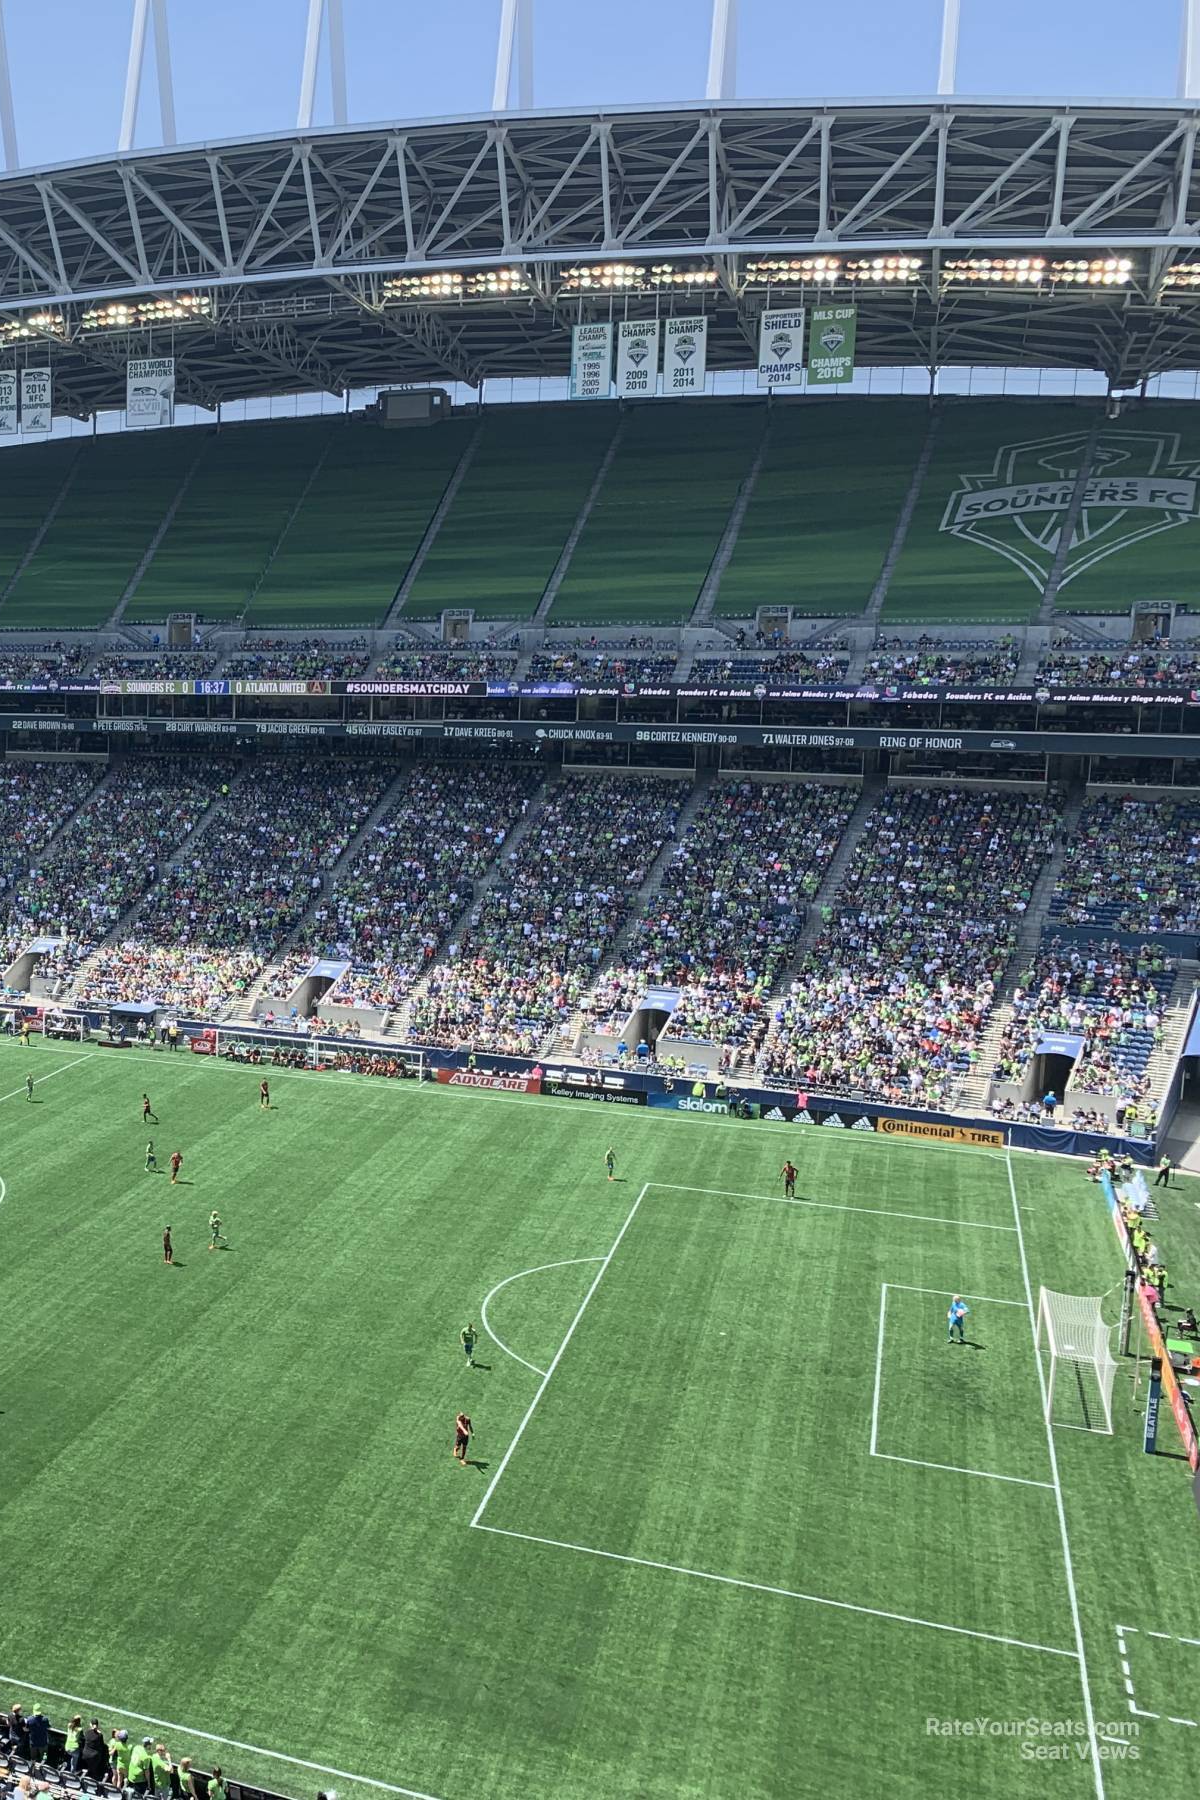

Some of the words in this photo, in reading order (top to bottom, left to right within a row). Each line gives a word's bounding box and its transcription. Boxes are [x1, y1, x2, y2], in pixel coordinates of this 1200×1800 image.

[814, 310, 833, 321] MLS
[835, 308, 855, 319] CUP
[668, 325, 704, 335] CHAMPS
[764, 319, 801, 330] SHIELD
[580, 327, 605, 335] LEAGUE
[622, 328, 656, 338] CHAMPS
[129, 362, 147, 371] 2013
[147, 360, 173, 369] WORLD
[760, 362, 801, 373] CHAMPS
[811, 357, 851, 369] CHAMPS
[129, 369, 173, 379] CHAMPIONS
[626, 370, 648, 380] 2009
[673, 368, 694, 377] 2011
[768, 373, 792, 383] 2014
[817, 368, 844, 379] 2016
[626, 381, 647, 390] 2010
[672, 378, 695, 388] 2014
[26, 384, 46, 394] 2014
[29, 395, 44, 403] NFC
[1149, 490, 1189, 506] FC
[126, 682, 165, 693] SOUNDERS
[165, 682, 175, 693] FC
[182, 682, 189, 693] 0
[200, 682, 225, 693] 16:37
[236, 682, 242, 693] 0
[245, 682, 280, 693] ATLANTA
[280, 682, 307, 693] UNITED
[346, 683, 470, 694] #SOUNDERSMATCHDAY
[639, 688, 670, 696] Sábados
[835, 691, 854, 700] Diego
[902, 691, 938, 699] Sábados
[1007, 693, 1033, 701] Acción
[1131, 695, 1154, 704] Diego
[12, 721, 23, 729] 22
[38, 721, 61, 730] BROWN
[98, 723, 113, 731] PETE
[114, 723, 134, 731] GROSS
[166, 723, 177, 731] 28
[178, 723, 194, 732] CURT
[194, 724, 222, 732] WARNER
[255, 725, 266, 733] 79
[268, 725, 288, 734] JACOB
[289, 725, 310, 734] GREEN
[359, 726, 380, 735] KENNY
[382, 726, 407, 736] EASLEY
[444, 727, 454, 736] 17
[455, 728, 473, 737] DAVE
[474, 728, 497, 738] KRIEG
[548, 729, 574, 740] CHUCK
[575, 729, 596, 740] KNOX
[636, 730, 650, 740] 96
[651, 731, 680, 741] CORTEZ
[681, 732, 719, 743] KENNEDY
[719, 735, 738, 743] 90-00
[762, 734, 774, 744] 71
[775, 735, 807, 745] WALTER
[808, 735, 835, 746] JONES
[835, 738, 855, 746] 97-09
[880, 736, 907, 748] RING
[909, 737, 923, 748] OF
[925, 738, 962, 749] HONOR
[450, 1074, 528, 1092] ADVOCARE
[552, 1088, 574, 1098] Kelley
[576, 1090, 605, 1102] Imaging
[607, 1092, 639, 1104] Systems
[678, 1098, 728, 1114] slalom
[882, 1120, 955, 1139] Continental
[970, 1133, 1000, 1144] TIRE
[1146, 1397, 1159, 1439] SEATTLE
